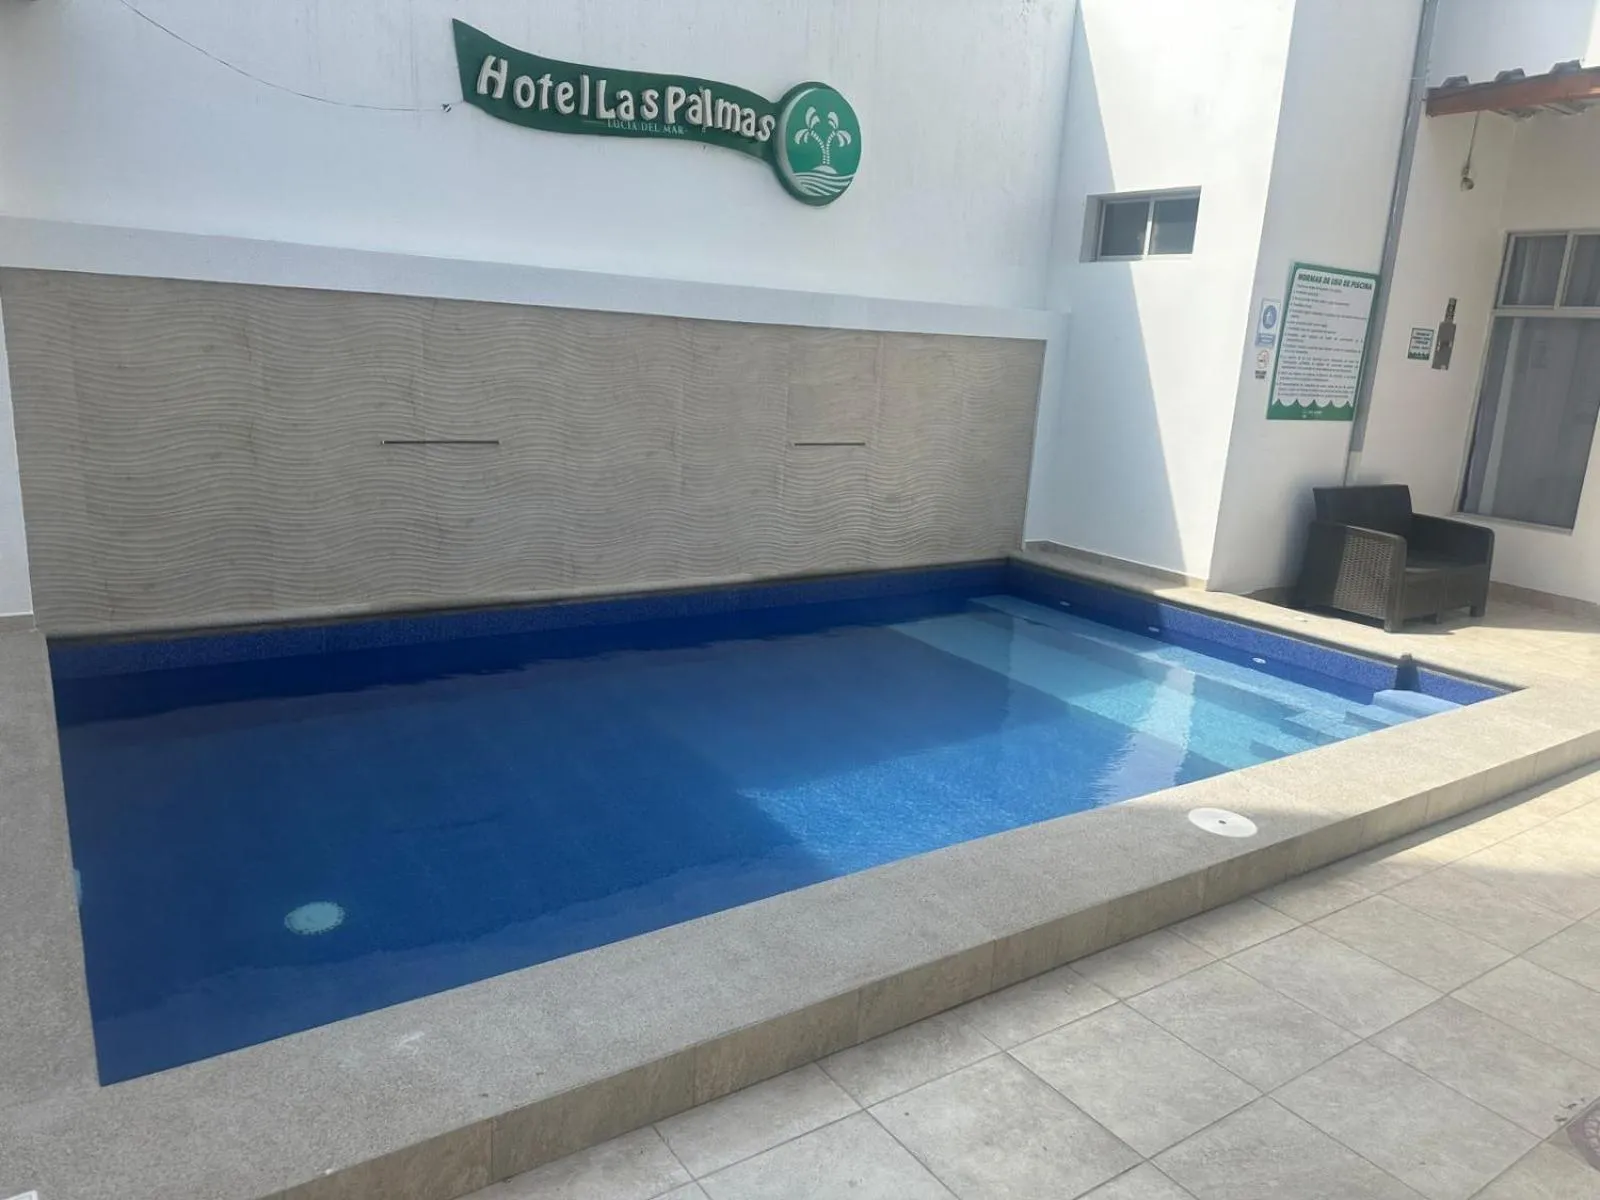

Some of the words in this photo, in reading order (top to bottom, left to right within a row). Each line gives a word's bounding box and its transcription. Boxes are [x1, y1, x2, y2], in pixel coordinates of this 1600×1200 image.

[477, 54, 589, 116] Hotel
[596, 79, 659, 120] Las
[664, 84, 775, 142] Palmas
[641, 122, 660, 132] DEL
[662, 124, 685, 135] MAR
[1298, 273, 1322, 284] NORMAS
[1322, 276, 1331, 286] DE
[1331, 277, 1342, 287] USO
[1342, 280, 1351, 288] DE
[1350, 281, 1373, 290] PISCINA
